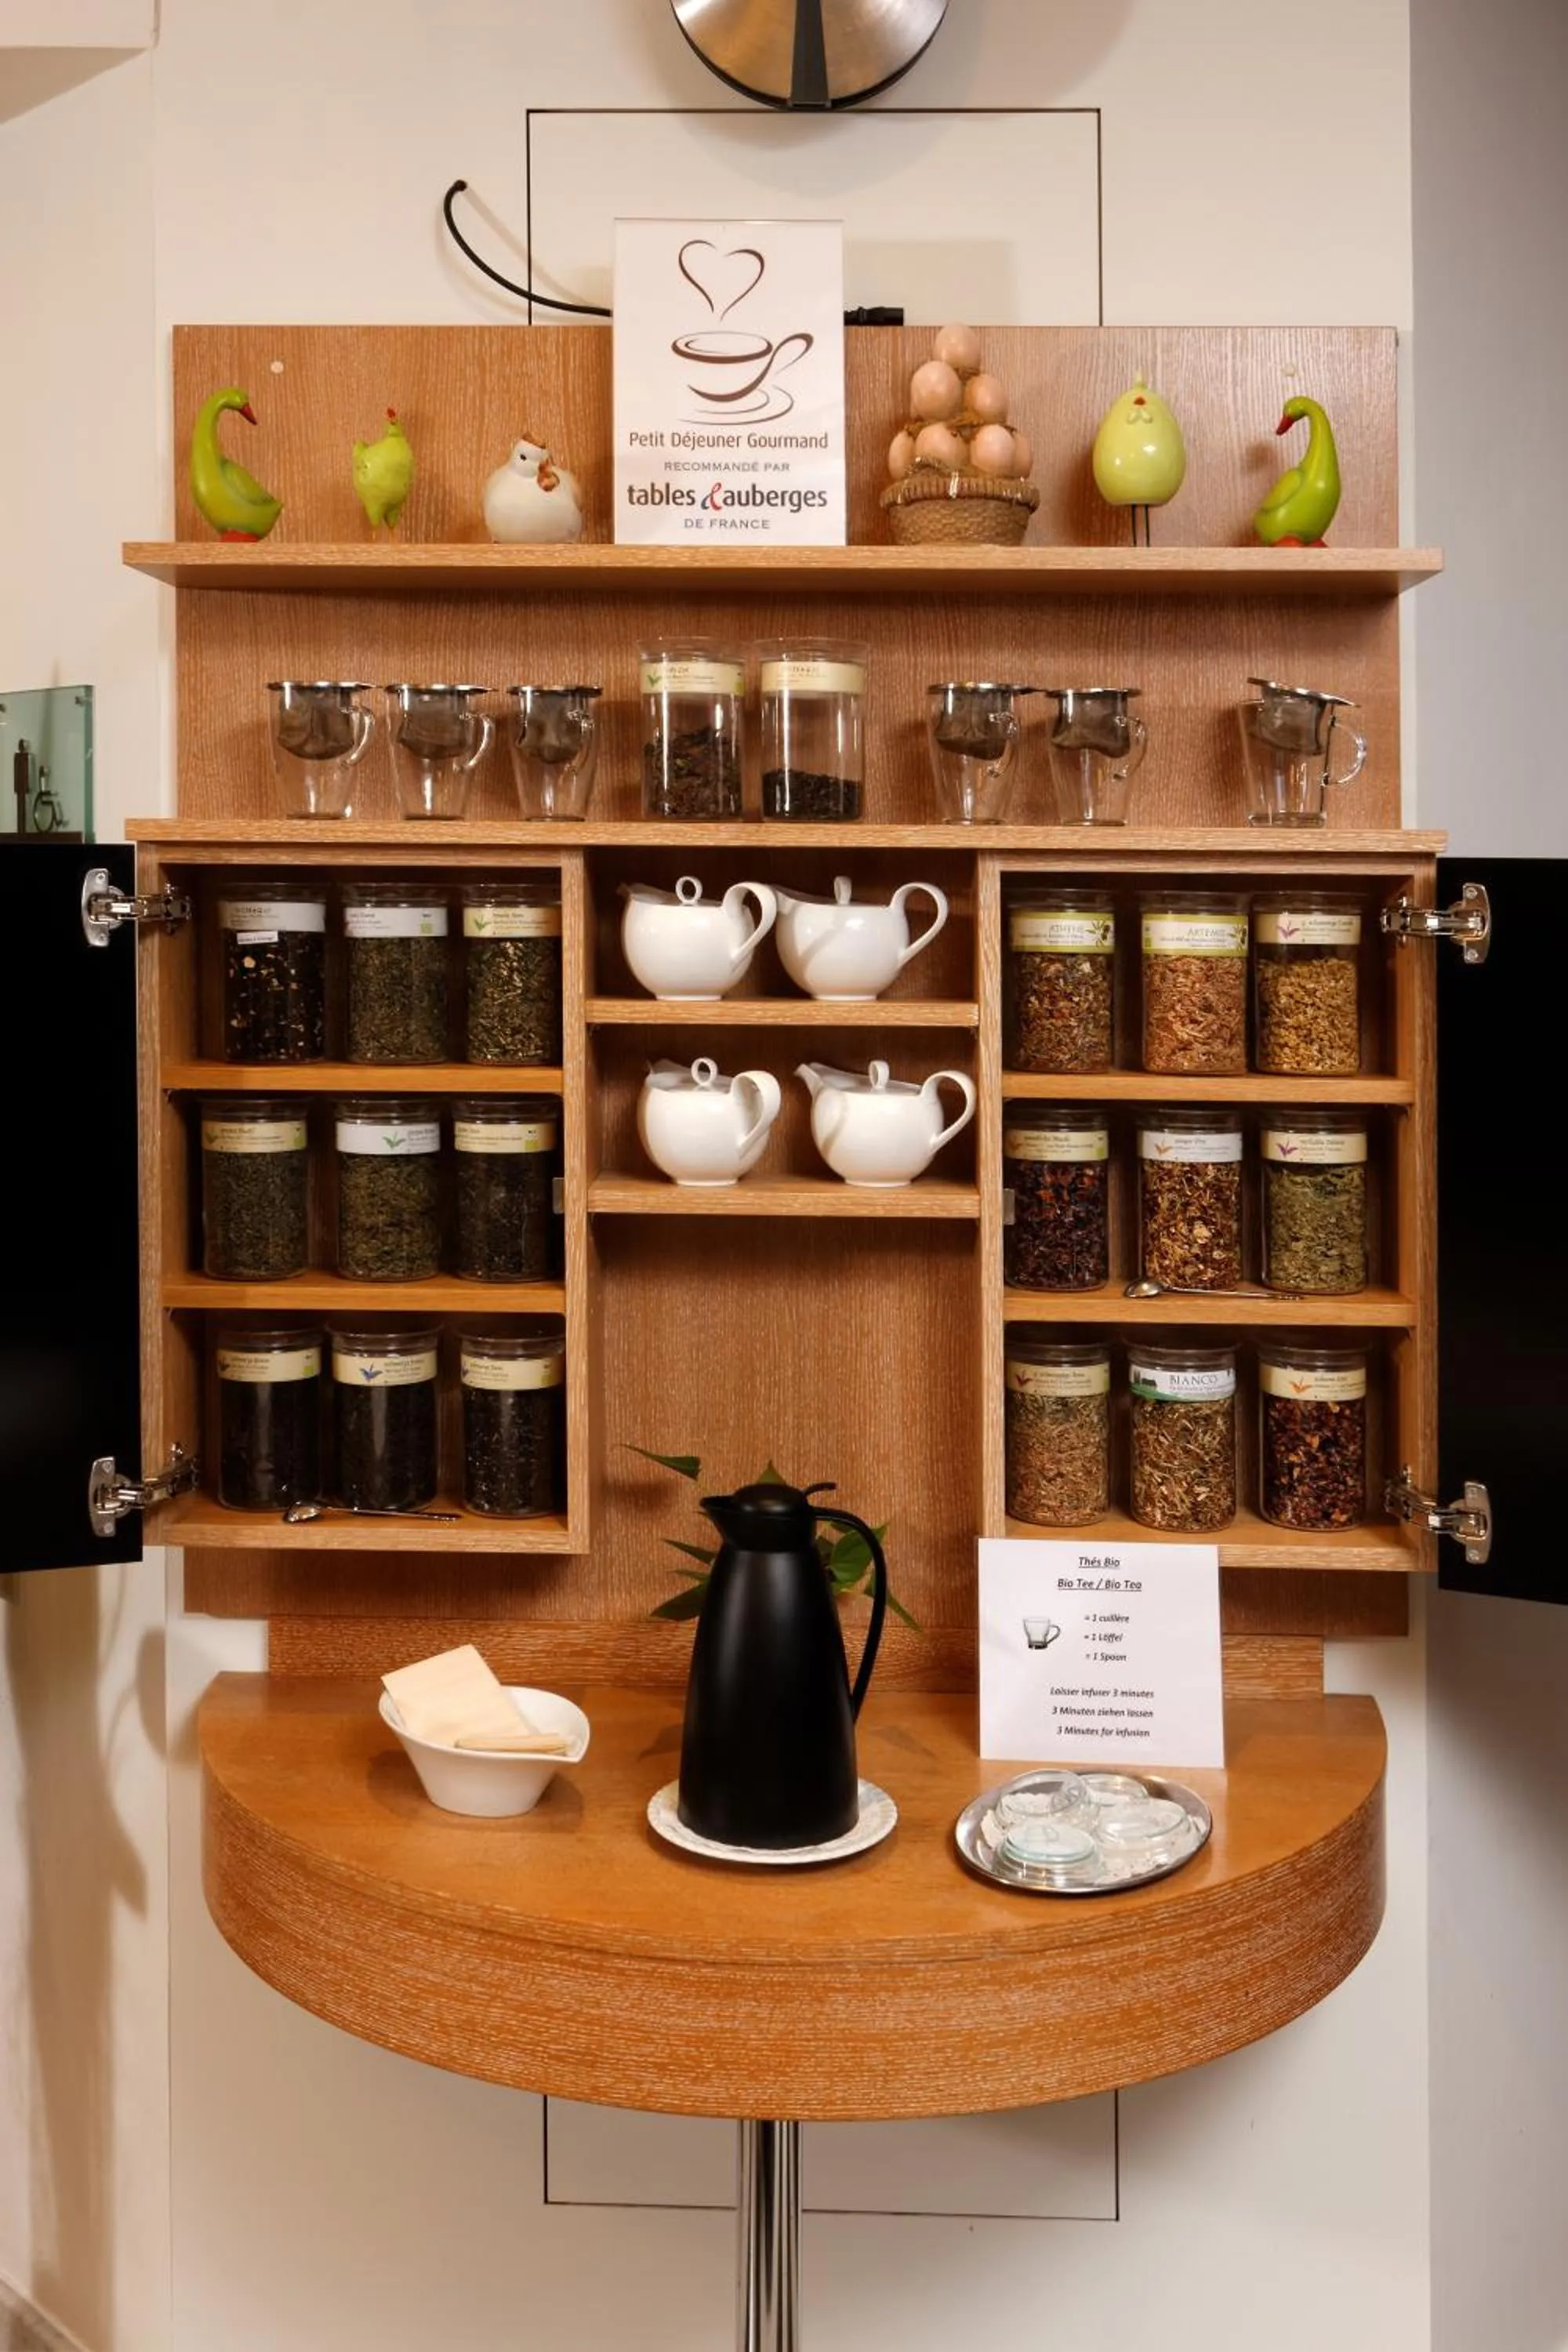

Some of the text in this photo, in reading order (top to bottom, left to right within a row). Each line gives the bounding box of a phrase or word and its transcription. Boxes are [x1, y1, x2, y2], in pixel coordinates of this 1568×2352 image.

[630, 431, 829, 451] Petit Déjeuner Gourmand
[664, 461, 790, 471] RECOMMANDÉ PAR
[627, 482, 695, 506] tables
[722, 483, 828, 513] auberges
[684, 518, 771, 529] DE FRANCE
[1169, 1374, 1218, 1385] BIANCO
[1078, 1556, 1121, 1568] Thés Bio
[1058, 1577, 1074, 1589] Bio
[1076, 1578, 1094, 1589] Tee
[1105, 1579, 1121, 1590] Bio
[1123, 1580, 1142, 1591] Tea
[1099, 1613, 1130, 1623] cuillère
[1098, 1633, 1123, 1643] Löffel
[1100, 1653, 1127, 1663] Spoon
[1050, 1686, 1155, 1699] Laisser infuser 3 minutes
[1052, 1706, 1154, 1718] 3 Minuten ziehen lassen
[1057, 1726, 1150, 1738] 3 Minutes for infusion
